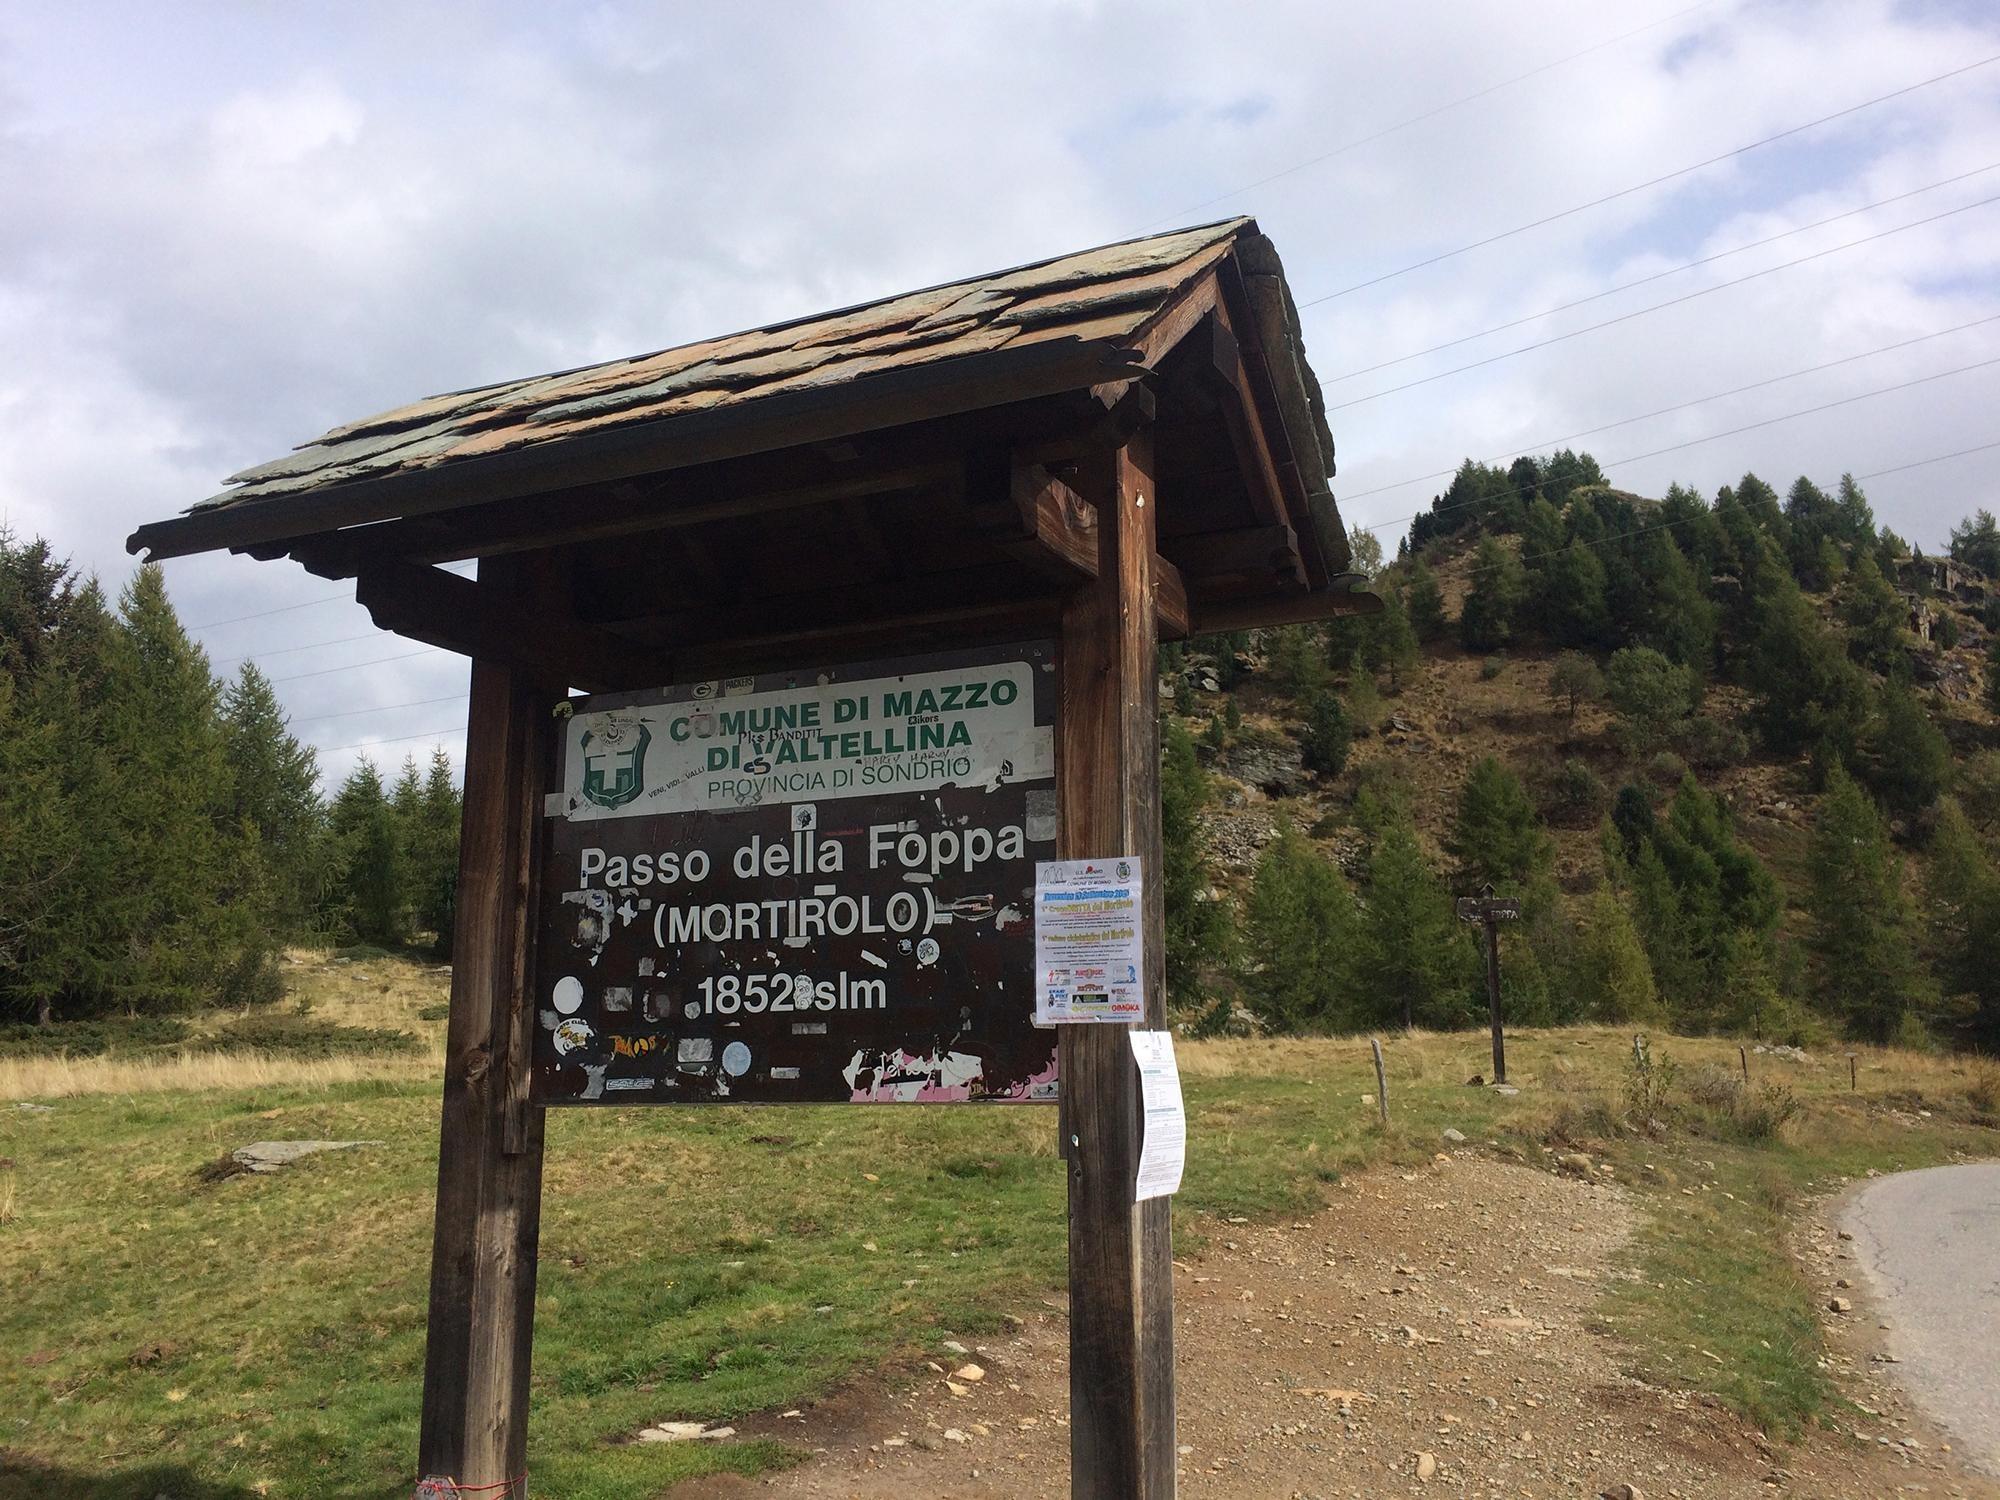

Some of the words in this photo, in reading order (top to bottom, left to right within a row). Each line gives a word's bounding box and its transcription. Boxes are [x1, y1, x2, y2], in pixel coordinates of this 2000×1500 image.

[834, 696, 869, 724] DI
[883, 679, 1018, 719] MAZZO
[707, 745, 740, 772] DI
[753, 720, 973, 766] VALTELLINA
[708, 771, 826, 800] PROVINCIA
[833, 768, 854, 788] DI
[861, 756, 971, 786] SONDRIO
[580, 847, 711, 889] Passo
[733, 830, 844, 879] della
[869, 823, 1025, 875] Foppa
[653, 886, 935, 948] (MORTIROLO)
[697, 972, 795, 1014] 1852
[814, 970, 887, 1011] slm
